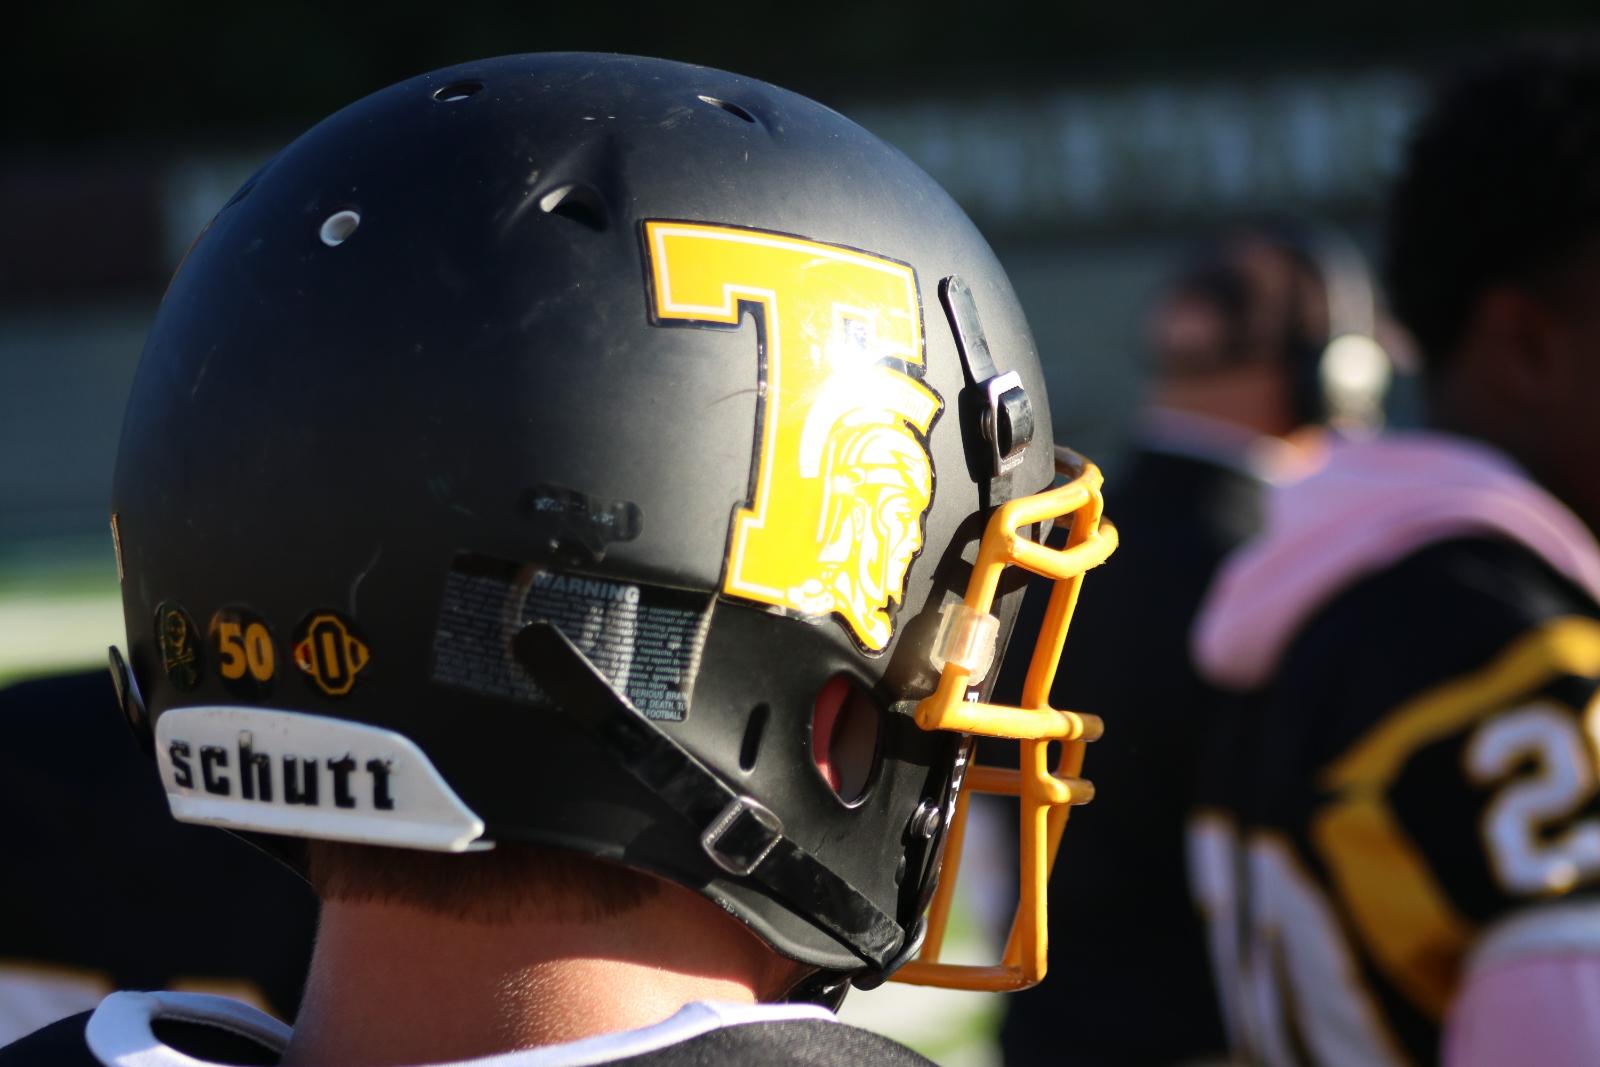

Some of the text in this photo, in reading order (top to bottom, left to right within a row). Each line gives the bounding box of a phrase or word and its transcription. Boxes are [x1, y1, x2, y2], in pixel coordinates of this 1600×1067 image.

[534, 574, 640, 603] WARNING
[219, 622, 275, 682] 50
[630, 688, 665, 700] SERIOUS
[646, 708, 682, 721] FOOTBALL
[168, 729, 396, 811] schutt
[1464, 688, 1600, 894] 2
